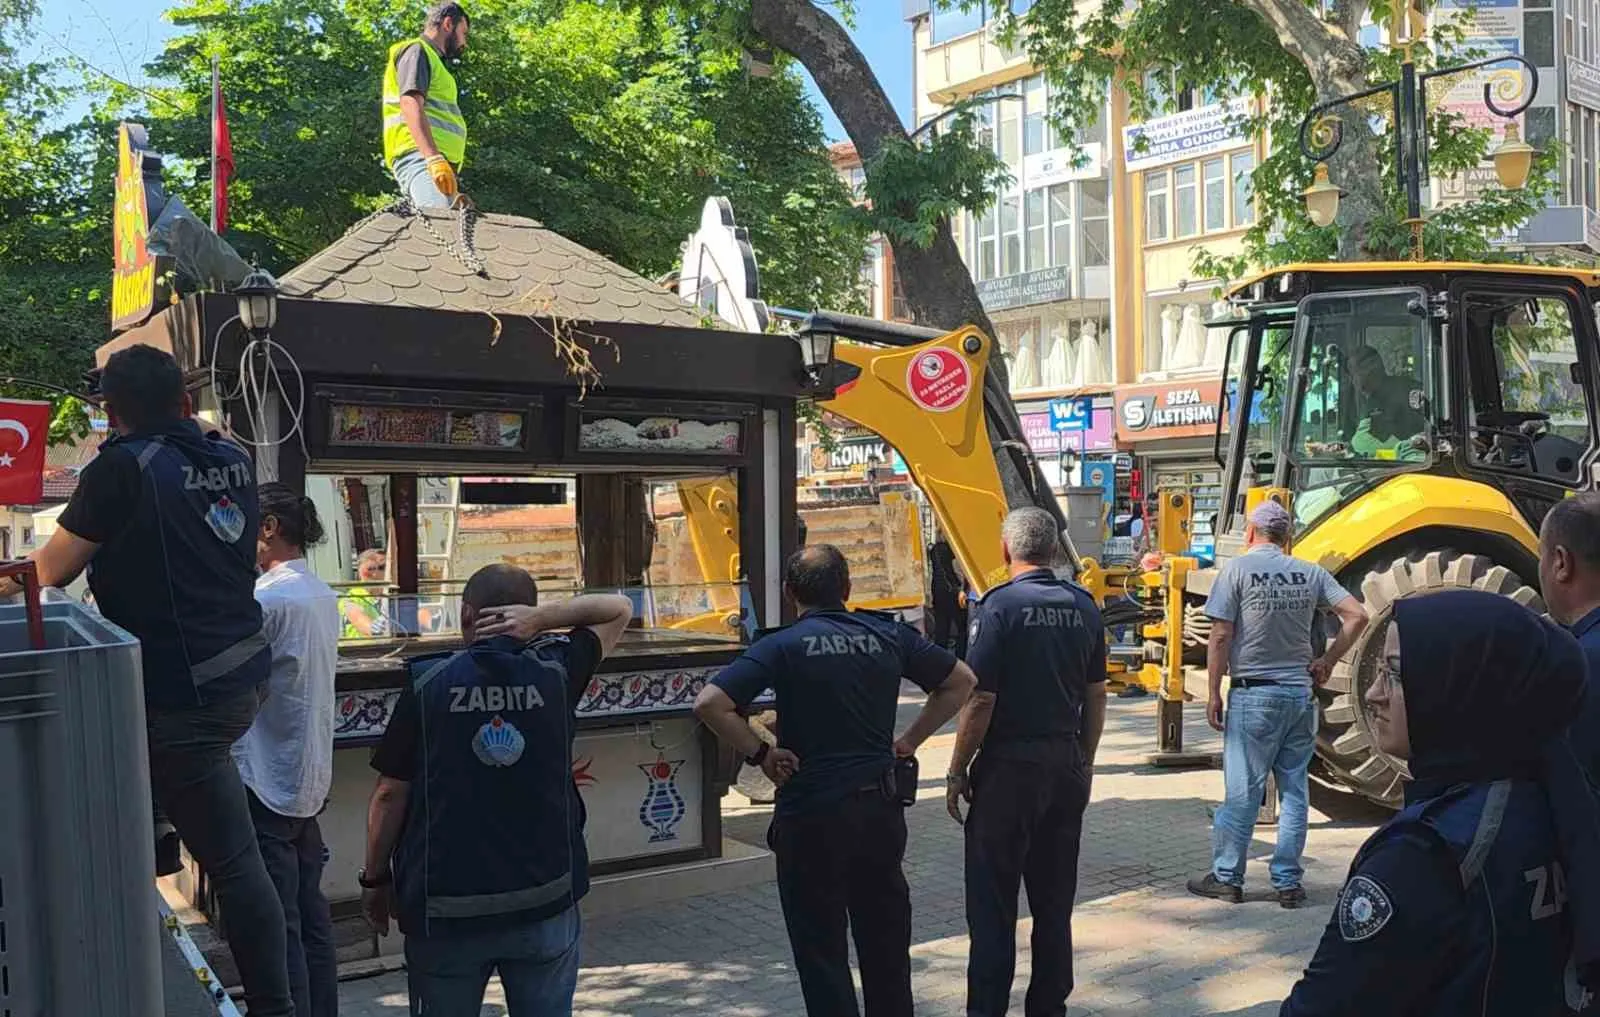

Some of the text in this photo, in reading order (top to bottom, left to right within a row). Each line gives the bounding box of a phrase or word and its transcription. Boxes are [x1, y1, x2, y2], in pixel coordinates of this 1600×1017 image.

[1167, 390, 1201, 406] SEFA
[1052, 401, 1086, 419] WC
[831, 443, 886, 467] KONAK
[1250, 571, 1307, 588] MAB
[1021, 606, 1084, 628] ZABITA
[803, 634, 883, 657] ZABITA
[449, 684, 545, 713] ZABITA
